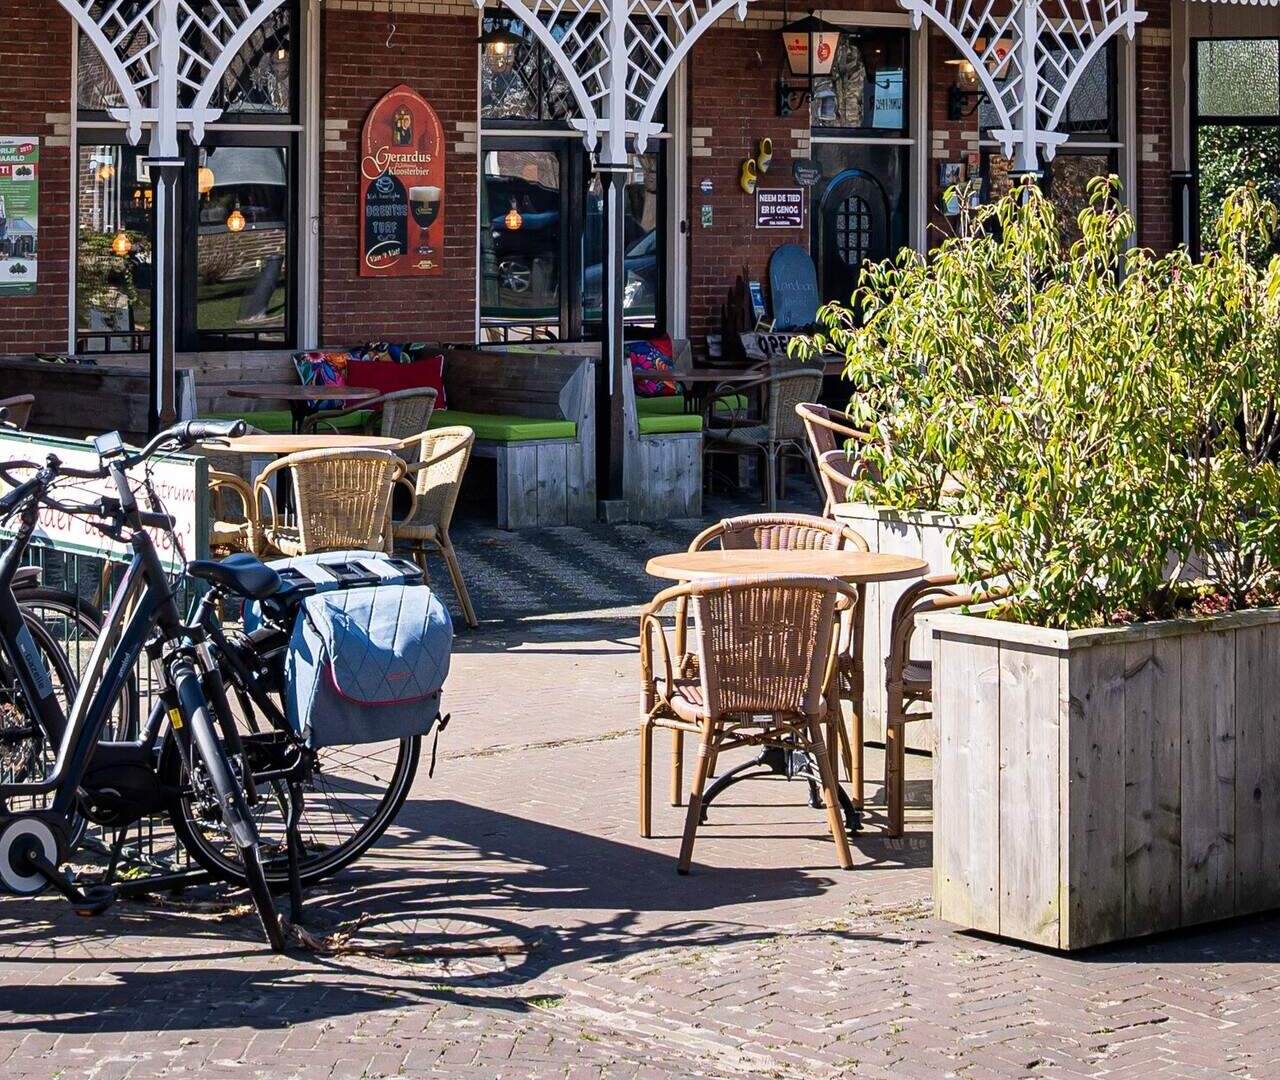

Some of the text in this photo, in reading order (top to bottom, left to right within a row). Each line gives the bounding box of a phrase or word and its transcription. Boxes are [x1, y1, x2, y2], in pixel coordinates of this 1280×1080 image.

[361, 145, 431, 180] Gerardus
[388, 166, 430, 176] Kloosterbier
[759, 194, 801, 202] NEEM DE TIED
[761, 206, 799, 214] ER IS GENOG
[369, 253, 383, 263] Van
[758, 335, 794, 354] OPE
